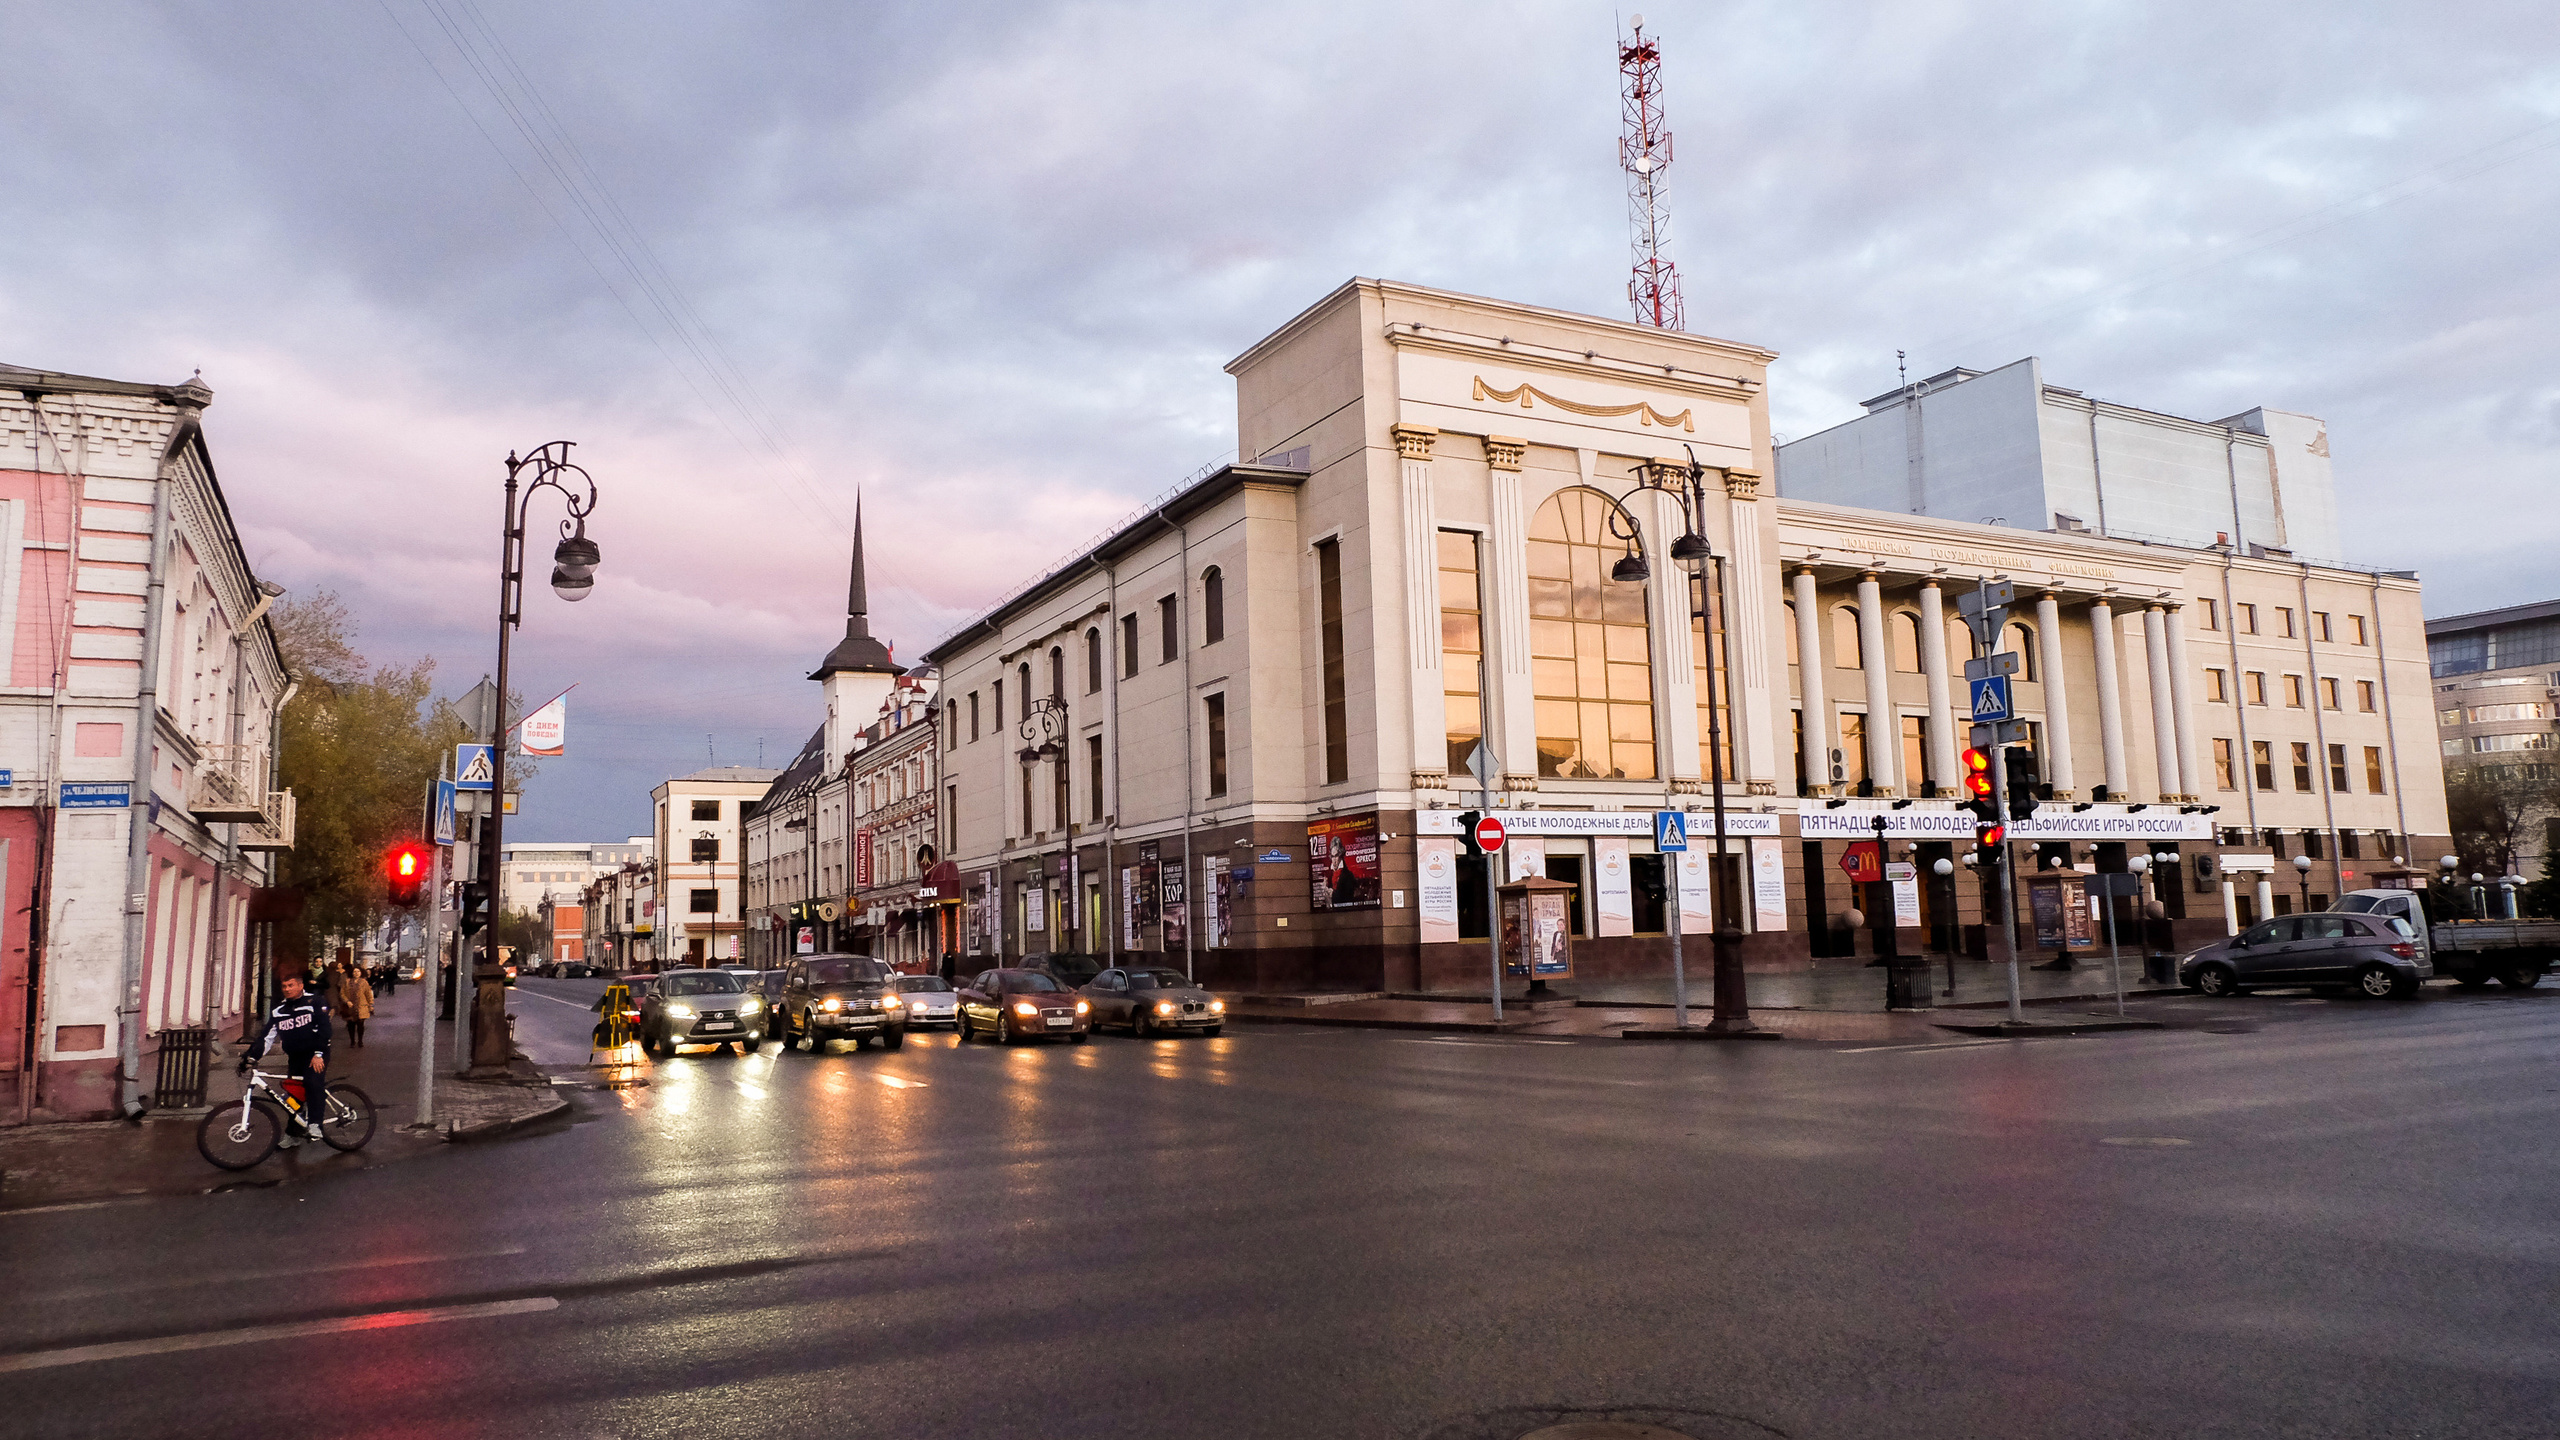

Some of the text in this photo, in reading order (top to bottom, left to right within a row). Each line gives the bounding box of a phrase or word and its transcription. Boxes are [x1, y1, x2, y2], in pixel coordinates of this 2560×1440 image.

[1840, 536, 2115, 579] ТЮМЕНСКАЯ ГОСУДАРСТВЕННАЯ ФИЛАРМОНИЯ
[526, 730, 559, 738] ПОБЕДЫ!
[527, 721, 559, 730] С ДНЕМ
[72, 785, 128, 796] ЧЕЛЮСКИНЦЕВ
[1540, 817, 1620, 829] МОЛОДЕЖНЫЕ
[1622, 818, 1698, 830] ДЕЛЬИЕ
[1730, 819, 1770, 829] РОССИИ
[1801, 815, 1906, 833] ПЯТНАДЦЫЕ
[2011, 815, 2100, 834] ДЕЛЬФИЙСКИЕ
[2103, 818, 2135, 832] ИГРЫ
[2138, 819, 2183, 832] РОССИИ
[1309, 835, 1318, 856] 12
[859, 835, 867, 881] ТЕАТРАЛЬНОЕ
[1356, 854, 1377, 863] ОРКЕСТР
[1164, 884, 1183, 902] ХОР
[278, 1013, 312, 1030] RUSSIA
[269, 1090, 295, 1114] FOCUS
